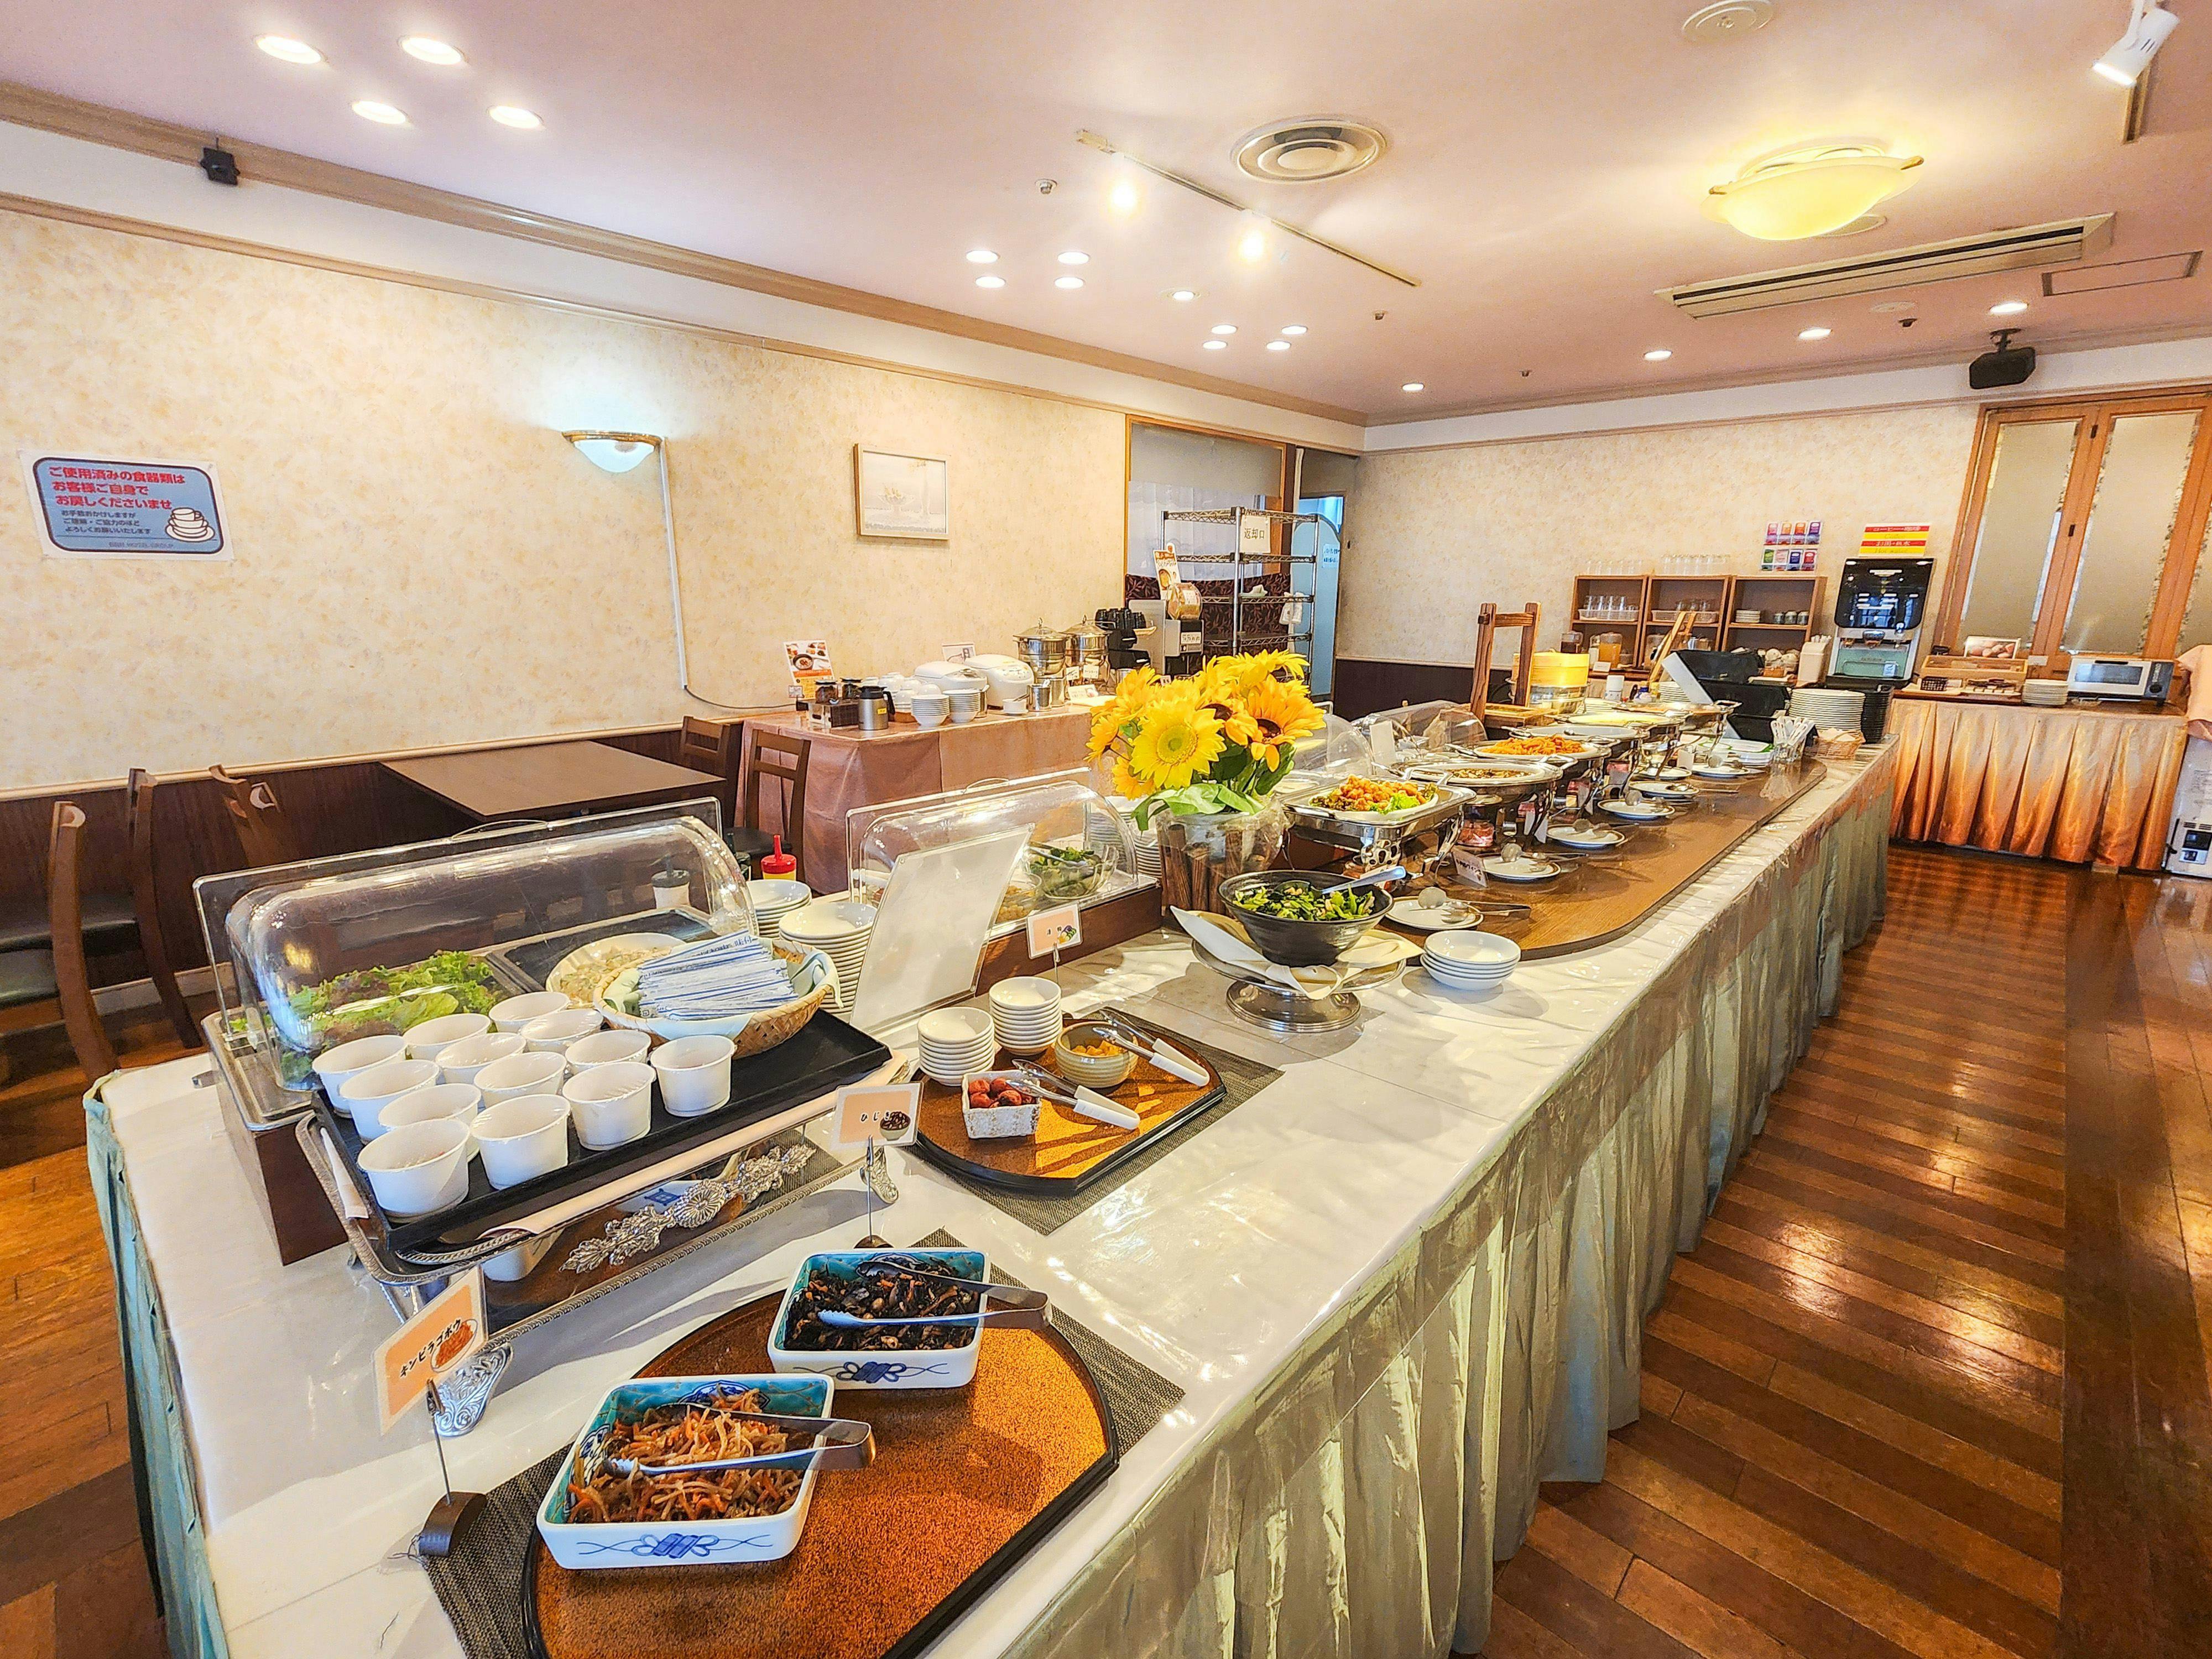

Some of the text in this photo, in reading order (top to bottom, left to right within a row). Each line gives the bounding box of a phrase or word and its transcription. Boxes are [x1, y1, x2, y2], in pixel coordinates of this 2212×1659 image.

[49, 467, 186, 484] ご使用済みの食器類は
[52, 481, 149, 495] お客様ご自身で
[55, 495, 173, 509] お戻しくださいませ
[1244, 528, 1265, 539] 返却口
[399, 1319, 462, 1378] キンピラゴボウ
